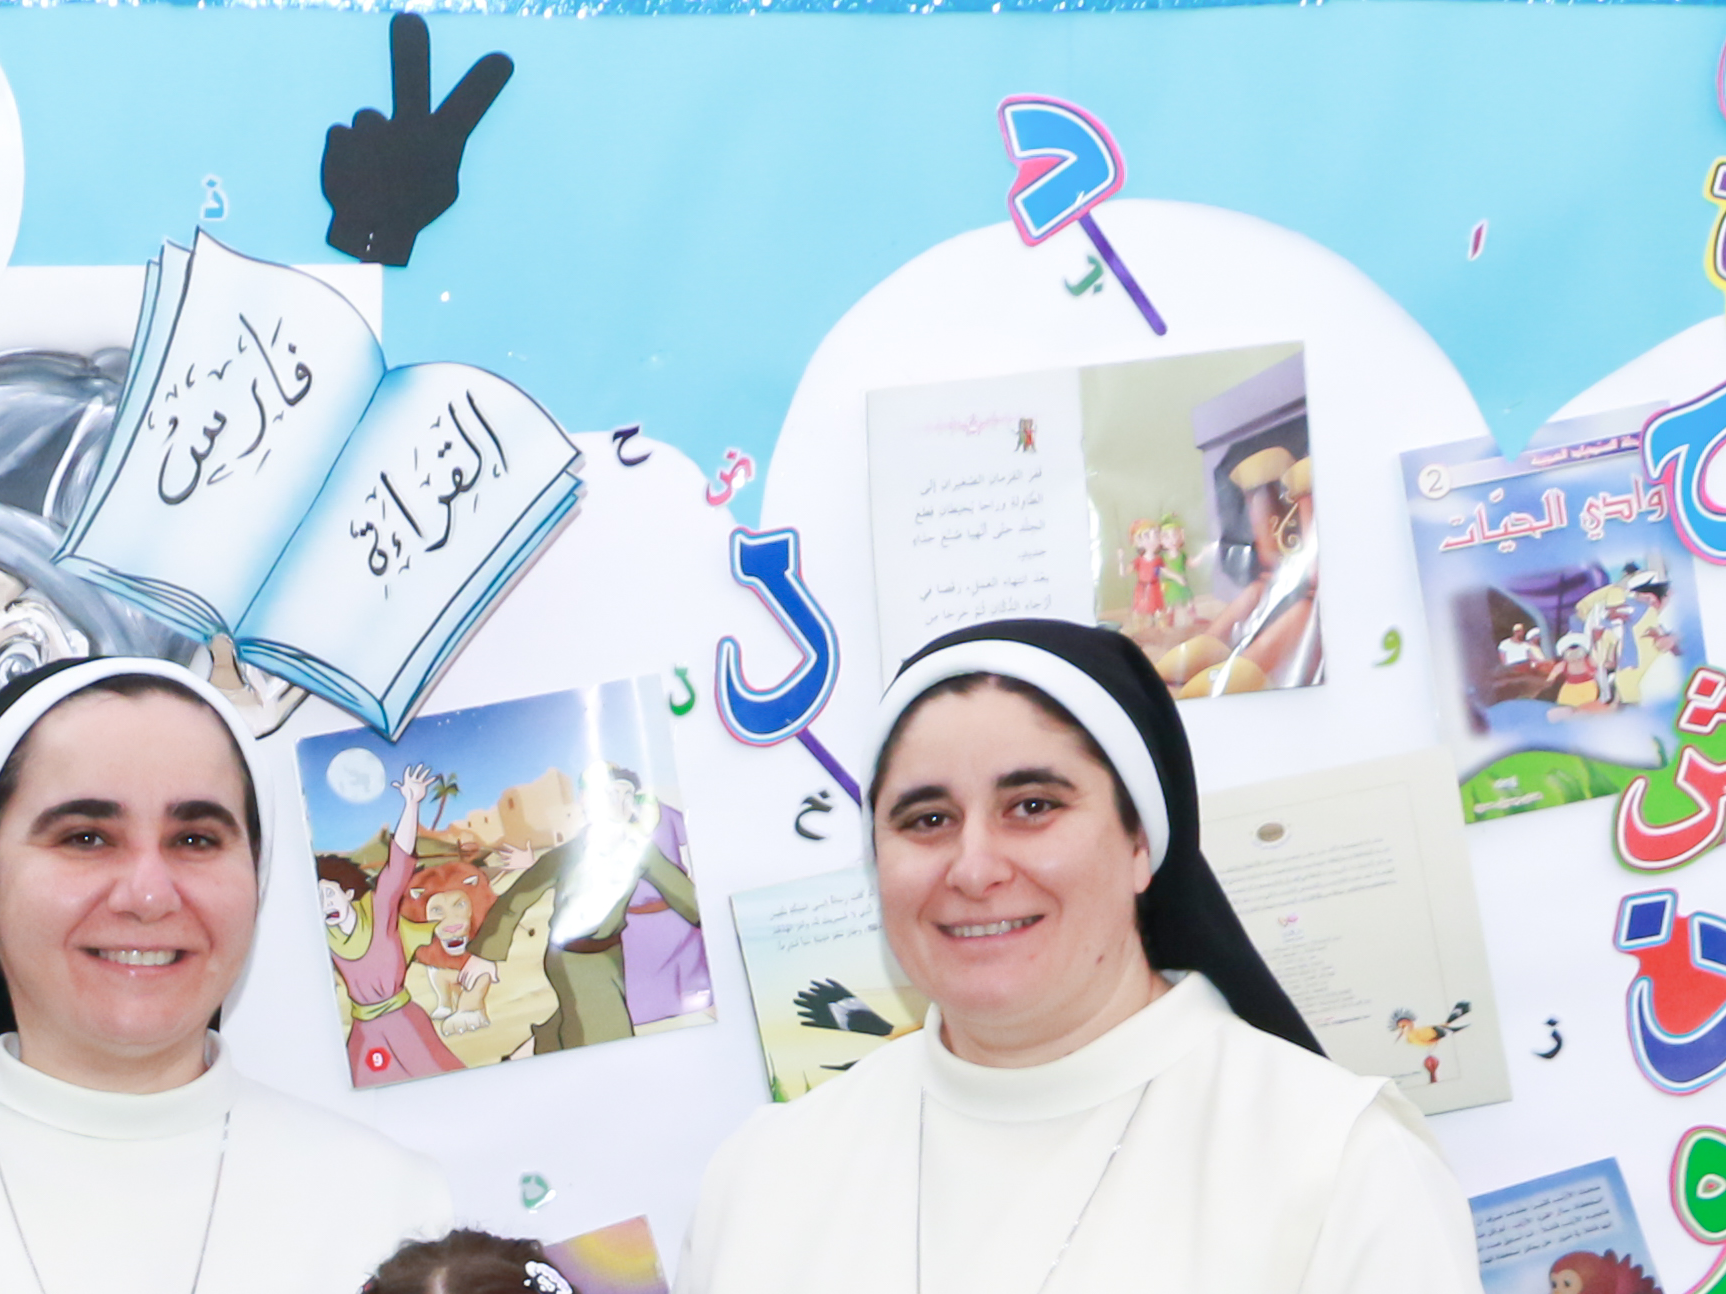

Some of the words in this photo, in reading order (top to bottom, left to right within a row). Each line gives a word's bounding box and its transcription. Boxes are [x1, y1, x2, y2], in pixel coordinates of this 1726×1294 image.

[612, 423, 651, 466] ح
[1425, 469, 1443, 493] 2
[1580, 474, 1668, 541] وادي
[1374, 629, 1403, 668] و
